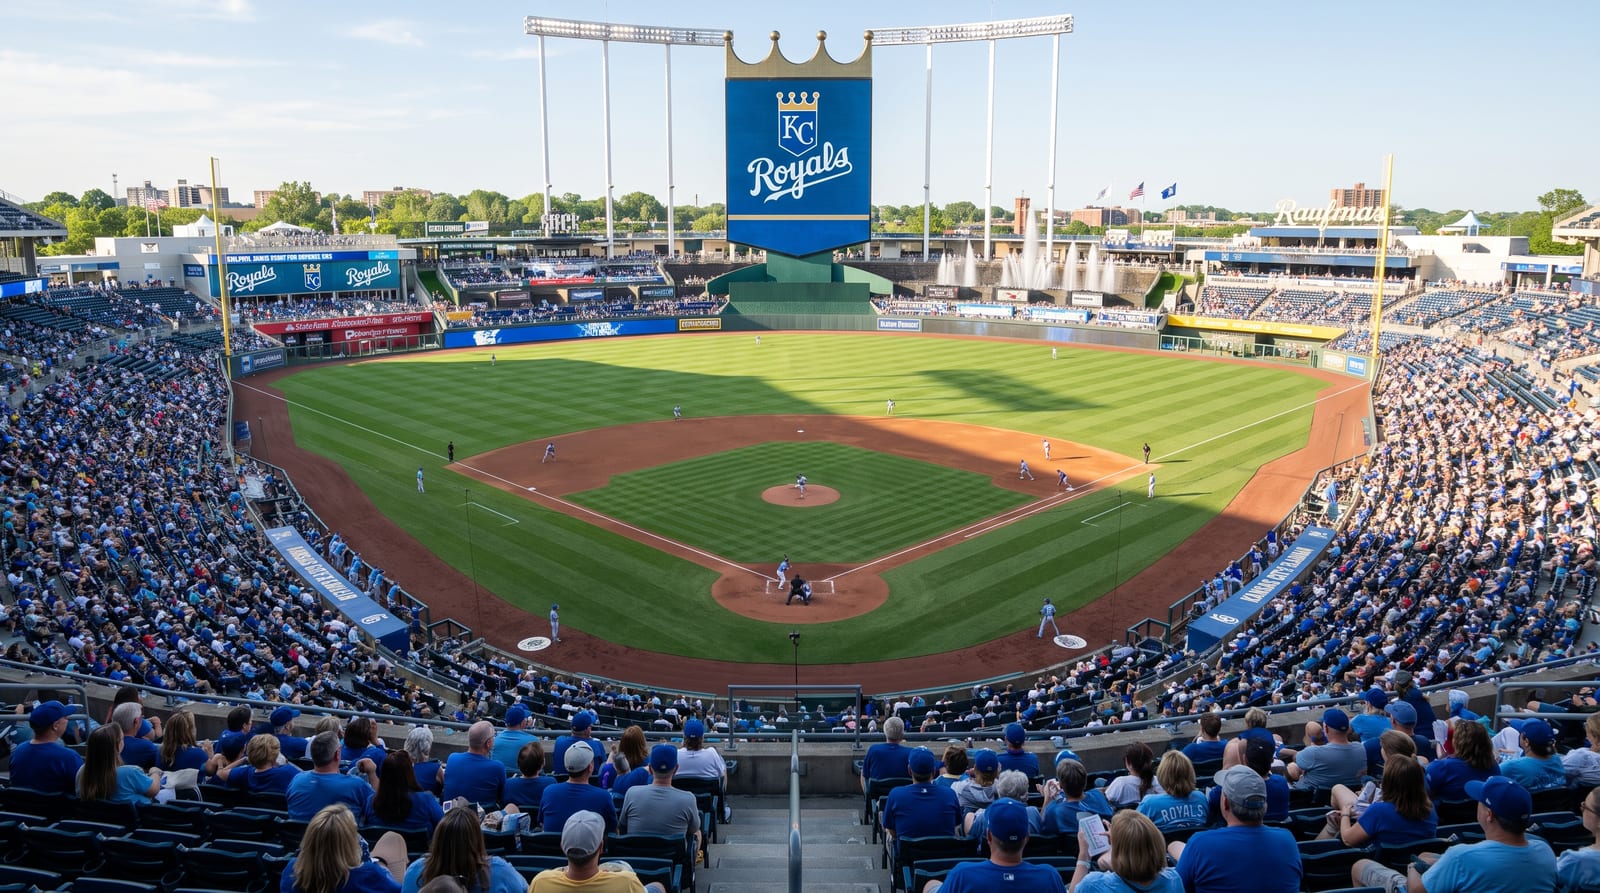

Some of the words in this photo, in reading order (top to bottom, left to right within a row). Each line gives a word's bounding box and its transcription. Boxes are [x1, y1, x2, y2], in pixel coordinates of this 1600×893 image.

[782, 115, 814, 145] KC
[747, 141, 853, 204] Royals
[225, 264, 277, 293] Royals
[306, 273, 320, 287] KC
[345, 261, 392, 288] Royals
[295, 322, 312, 331] State
[1240, 578, 1281, 604] KANSAS
[1160, 804, 1204, 823] ROYALS
